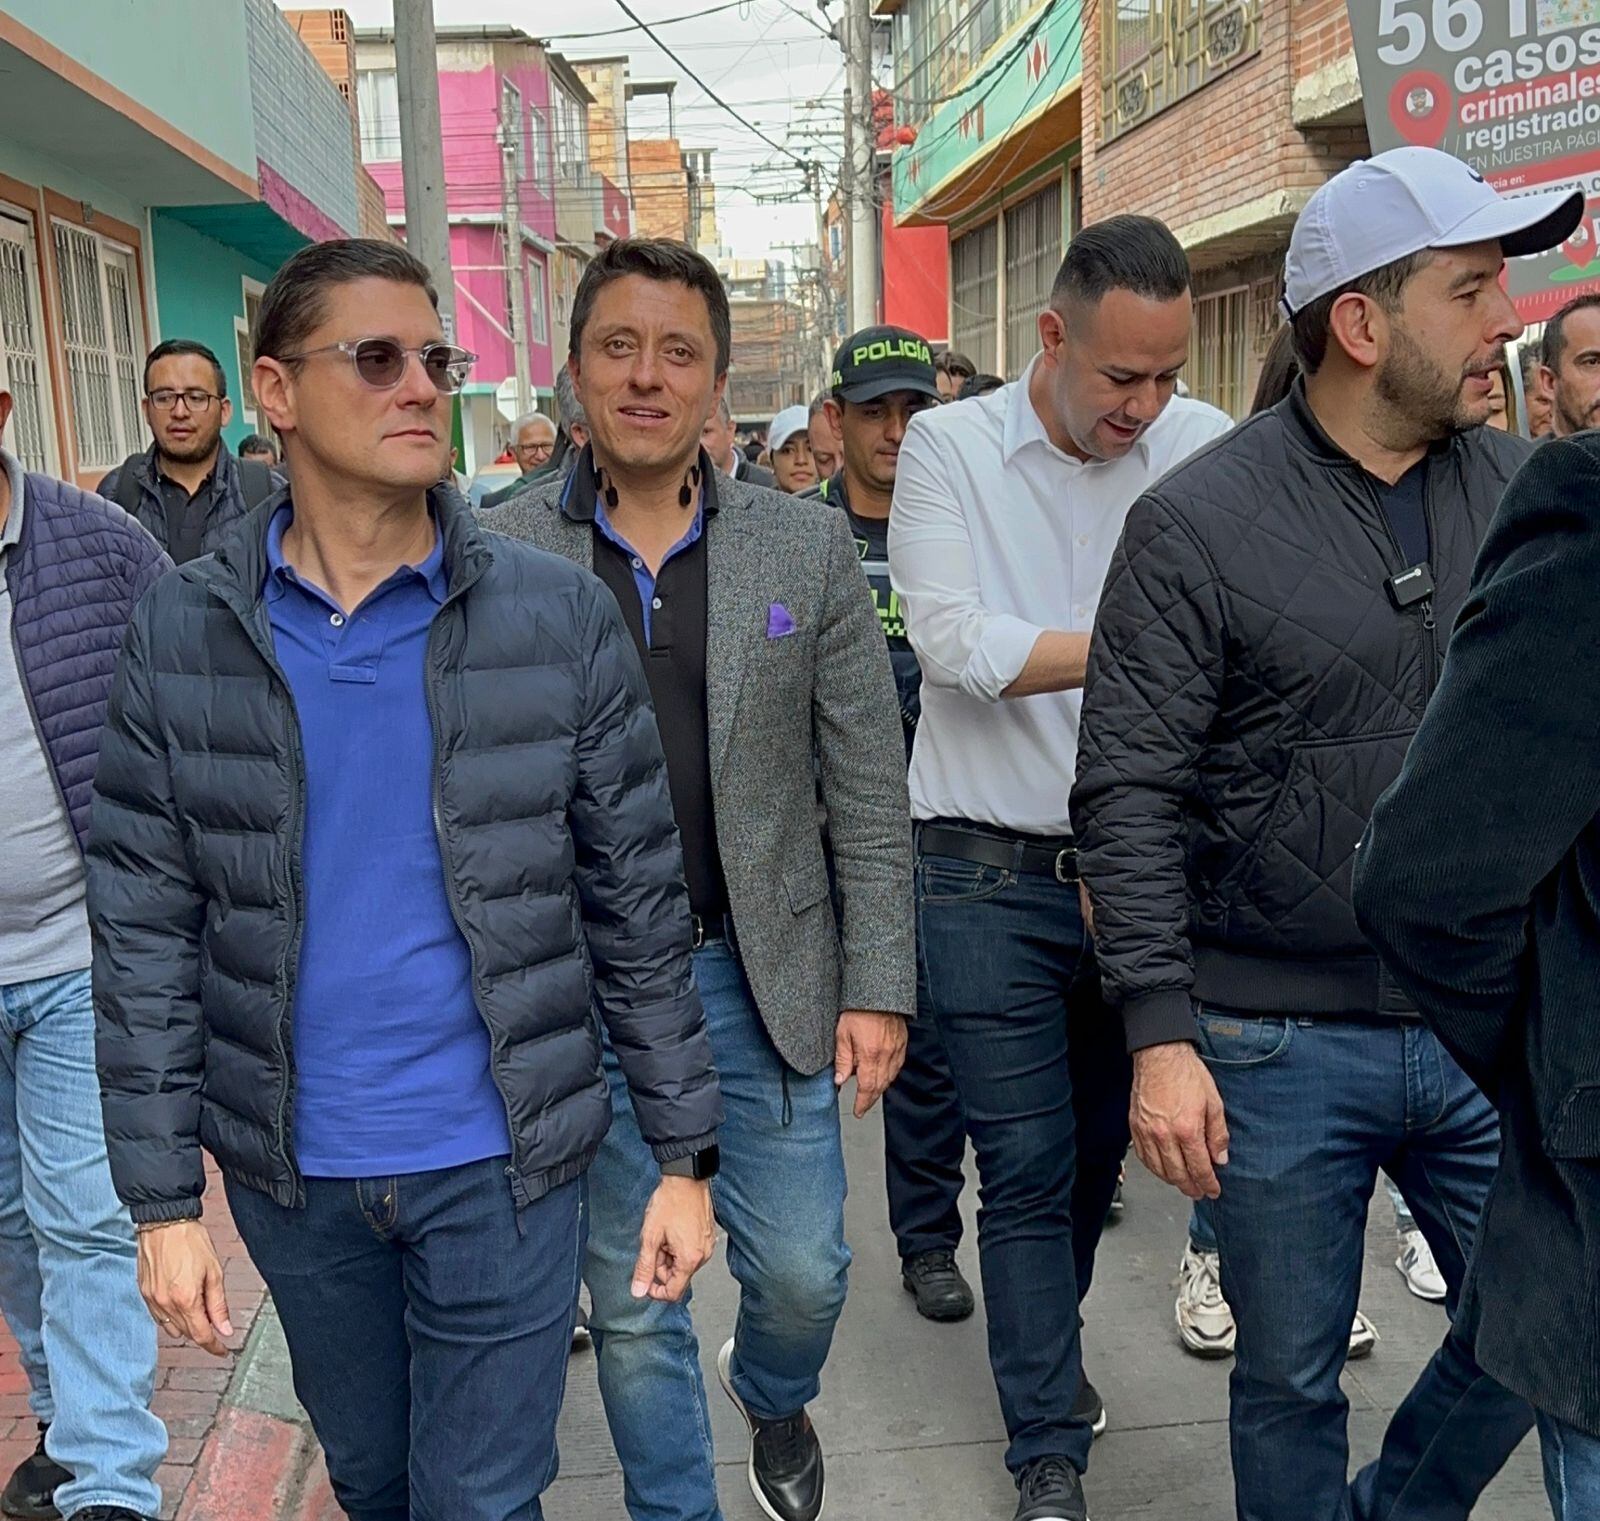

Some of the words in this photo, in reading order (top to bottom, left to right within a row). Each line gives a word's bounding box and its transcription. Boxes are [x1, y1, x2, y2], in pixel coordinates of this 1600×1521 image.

[1454, 27, 1600, 93] casos
[1491, 139, 1563, 167] NUESTRA
[853, 339, 932, 366] POLICÍA
